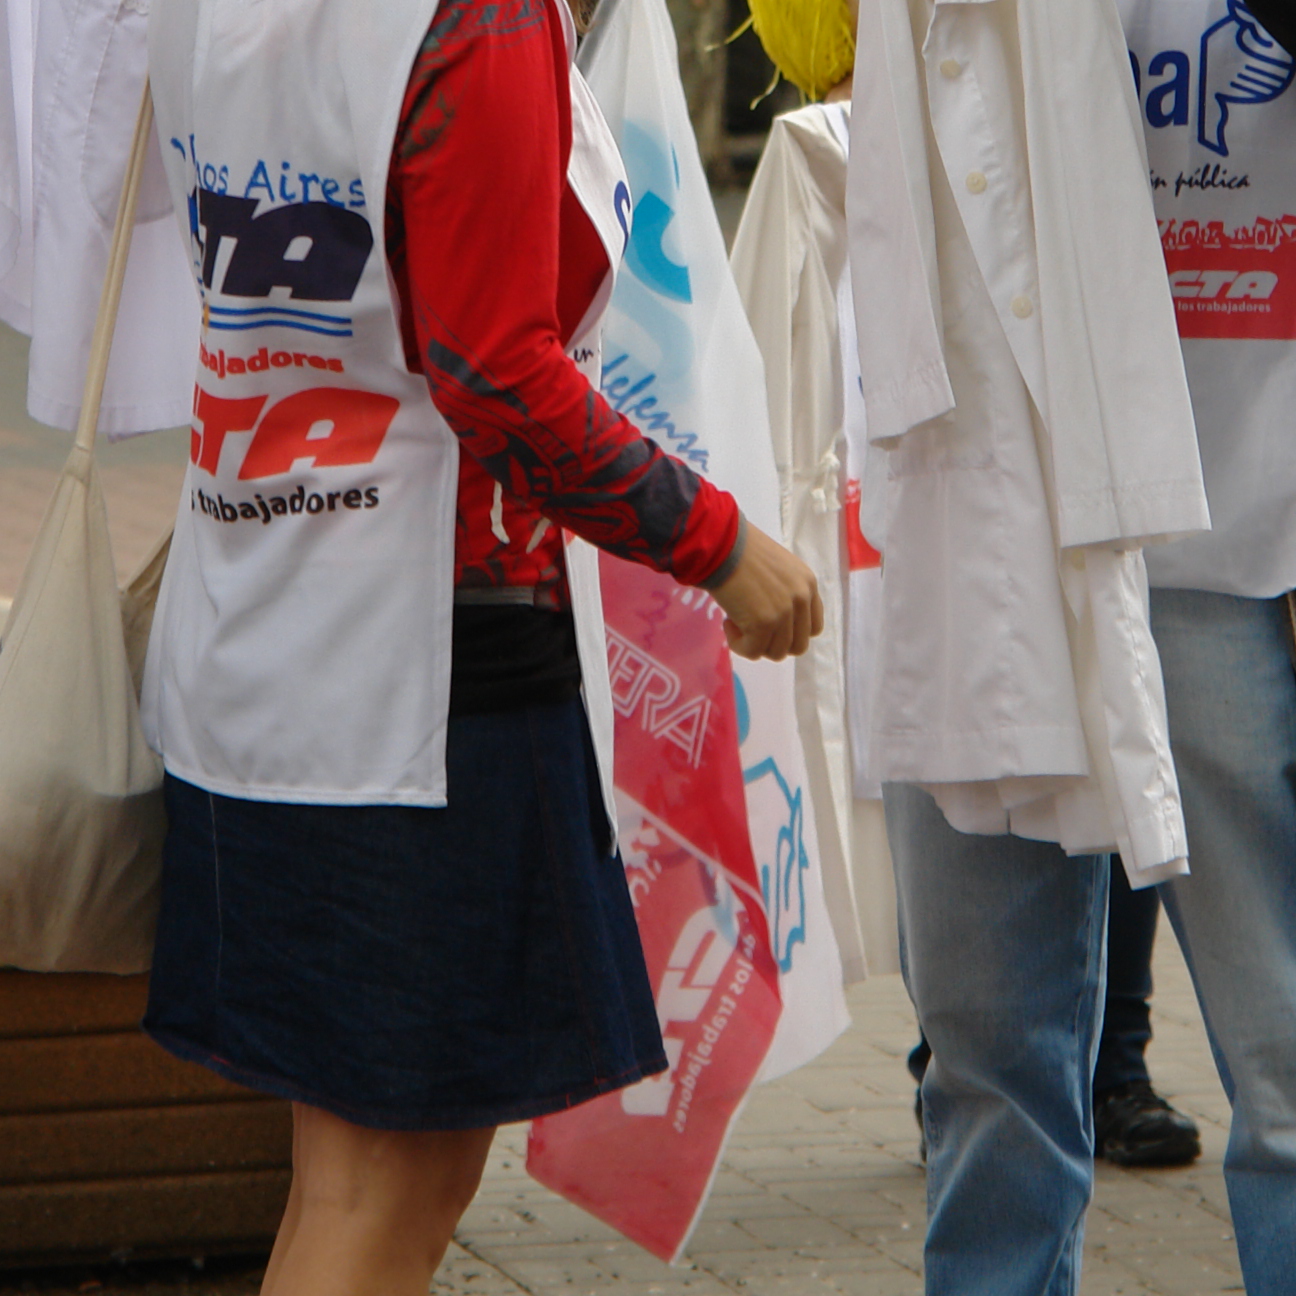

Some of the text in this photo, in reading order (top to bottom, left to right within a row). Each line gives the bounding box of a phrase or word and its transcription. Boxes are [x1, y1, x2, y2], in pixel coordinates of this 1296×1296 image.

[245, 159, 366, 209] Aires
[1175, 163, 1250, 197] pública
[193, 185, 374, 301] TA
[1170, 270, 1278, 299] CTA
[1197, 301, 1271, 315] trabajadores
[191, 382, 400, 480] TA
